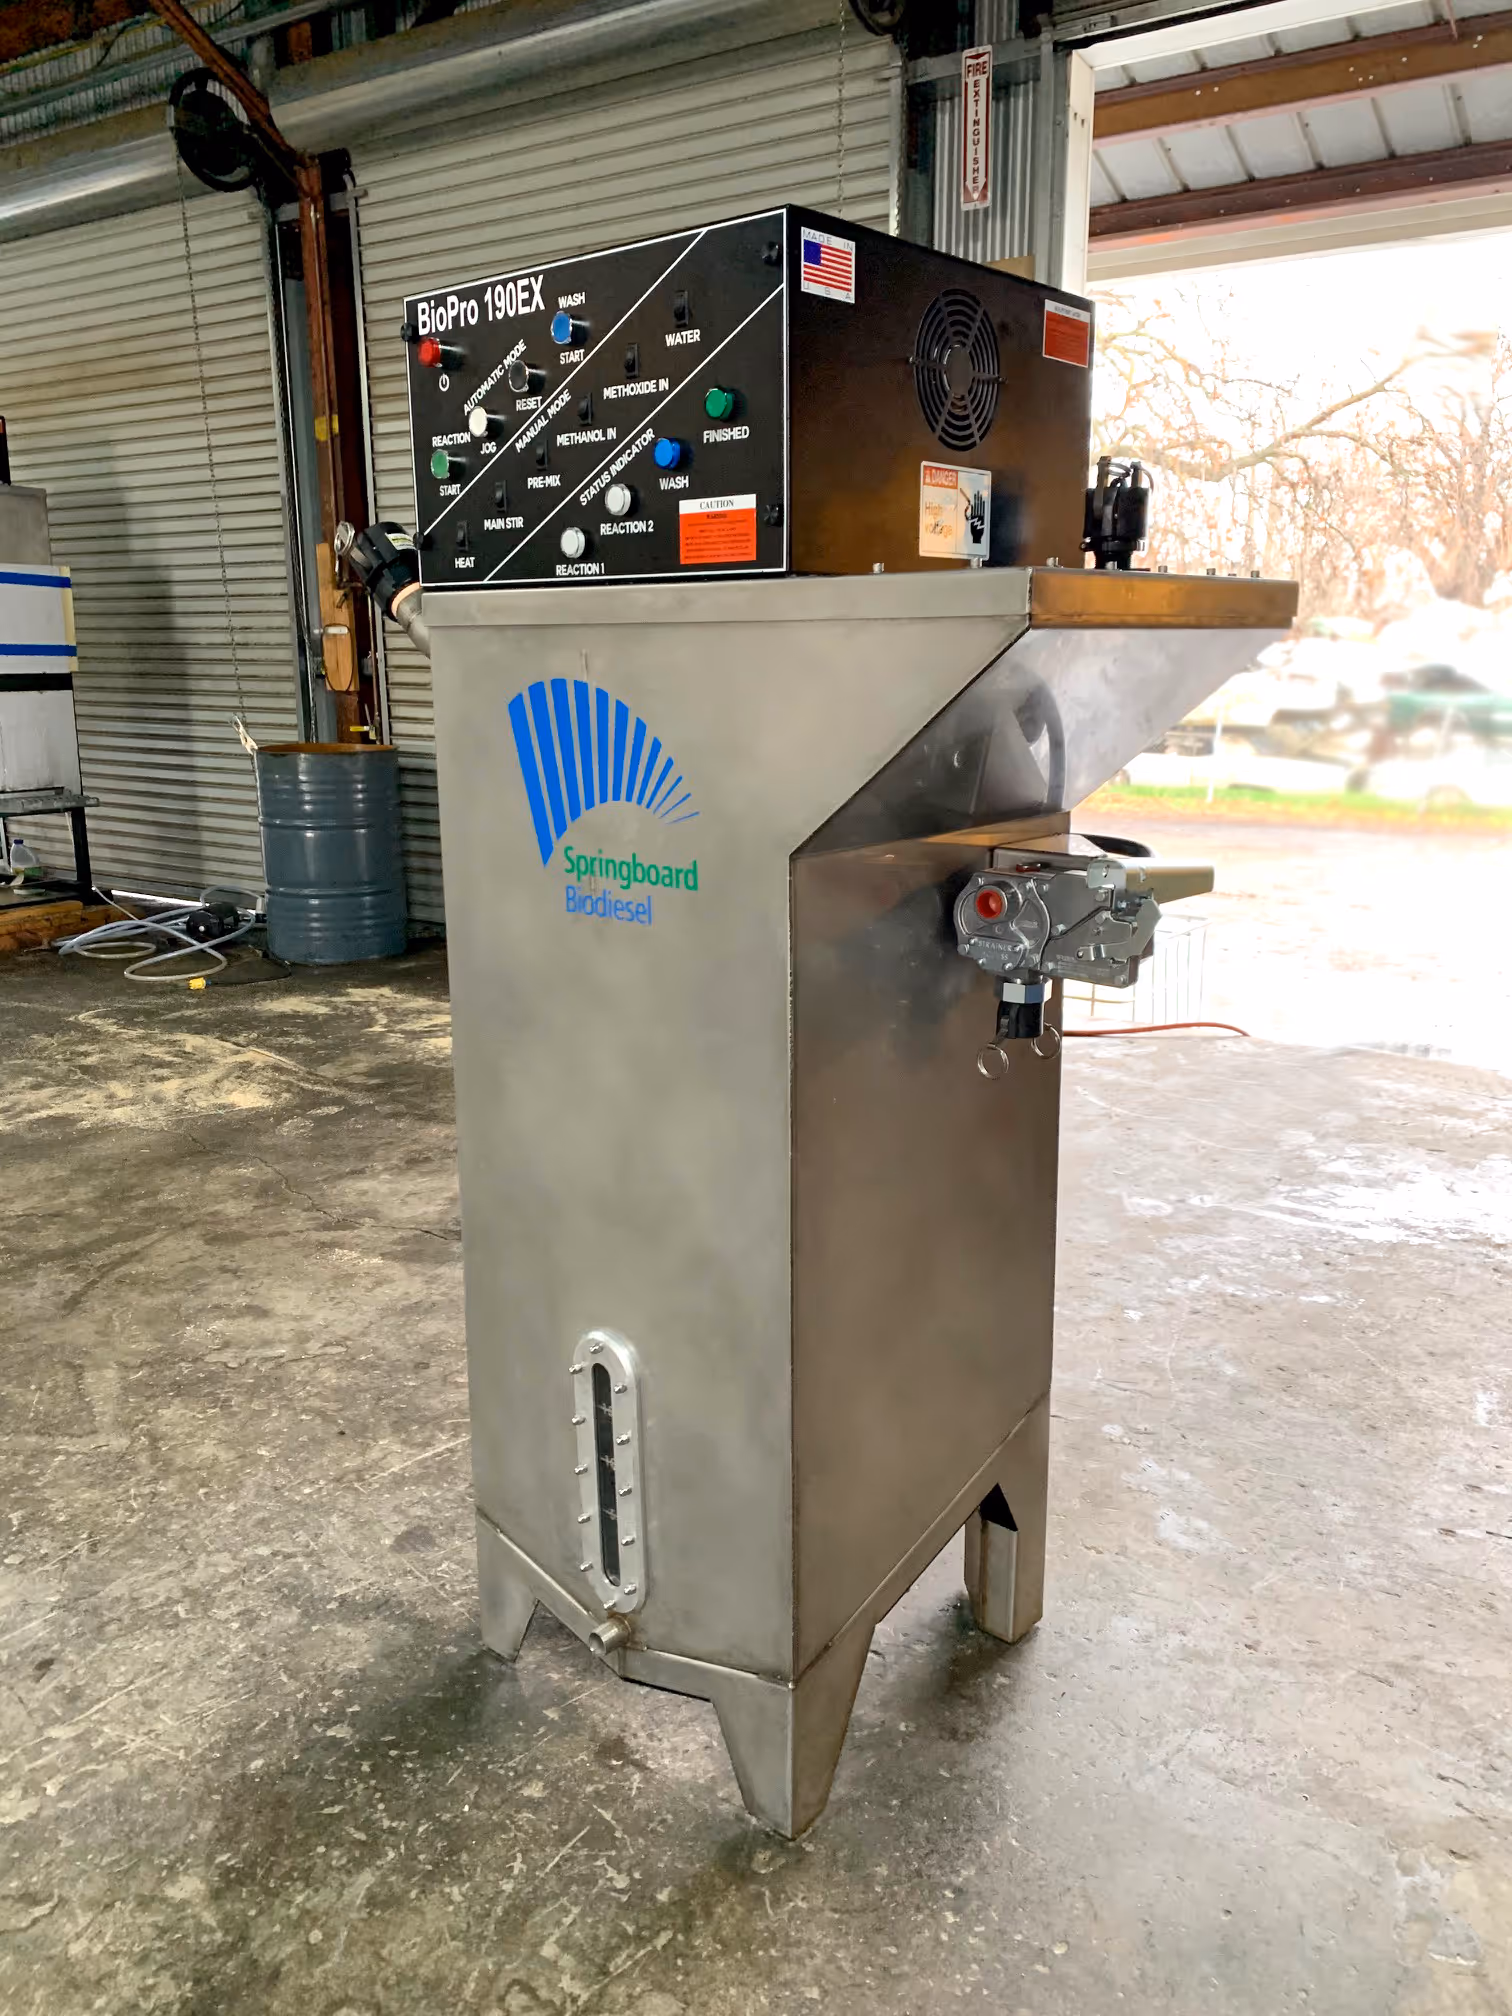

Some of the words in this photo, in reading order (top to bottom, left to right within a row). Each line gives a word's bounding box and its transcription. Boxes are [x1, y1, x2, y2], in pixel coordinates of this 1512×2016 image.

[966, 61, 988, 79] FIRE
[972, 78, 980, 194] EXTINGUISHER
[803, 229, 832, 245] MADE
[844, 242, 852, 251] IN
[417, 294, 479, 336] BioPro
[484, 274, 545, 322] 190EX
[558, 292, 586, 309] WASH
[665, 329, 701, 347] WATER
[559, 349, 585, 364] START
[463, 364, 505, 416] AUTOMATIC
[503, 338, 527, 369] MODE
[603, 380, 657, 400] METHOXIDE
[658, 377, 669, 391] IN
[515, 396, 542, 412] RESET
[515, 414, 549, 453] MANUAL
[546, 389, 572, 419] MODE
[432, 432, 471, 448] REACTION
[556, 431, 606, 447] METHANOL
[606, 427, 617, 440] IN
[703, 426, 750, 444] FINISHED
[480, 442, 497, 455] JOG
[579, 472, 612, 506] STATUS
[608, 427, 656, 479] INDICATOR
[527, 475, 562, 489] PRE-MIX
[659, 475, 690, 491] WASH
[932, 468, 957, 486] DANGER
[439, 484, 462, 497] START
[699, 499, 735, 510] CAUTION
[484, 519, 506, 531] MAIN
[506, 516, 524, 530] STIR
[600, 521, 647, 536] REACTION
[648, 519, 655, 533] 2
[454, 557, 476, 569] HEAT
[555, 564, 599, 577] REACTION
[600, 562, 606, 575] 1
[563, 845, 699, 892] Springboard
[565, 884, 653, 926] Biodiesel
